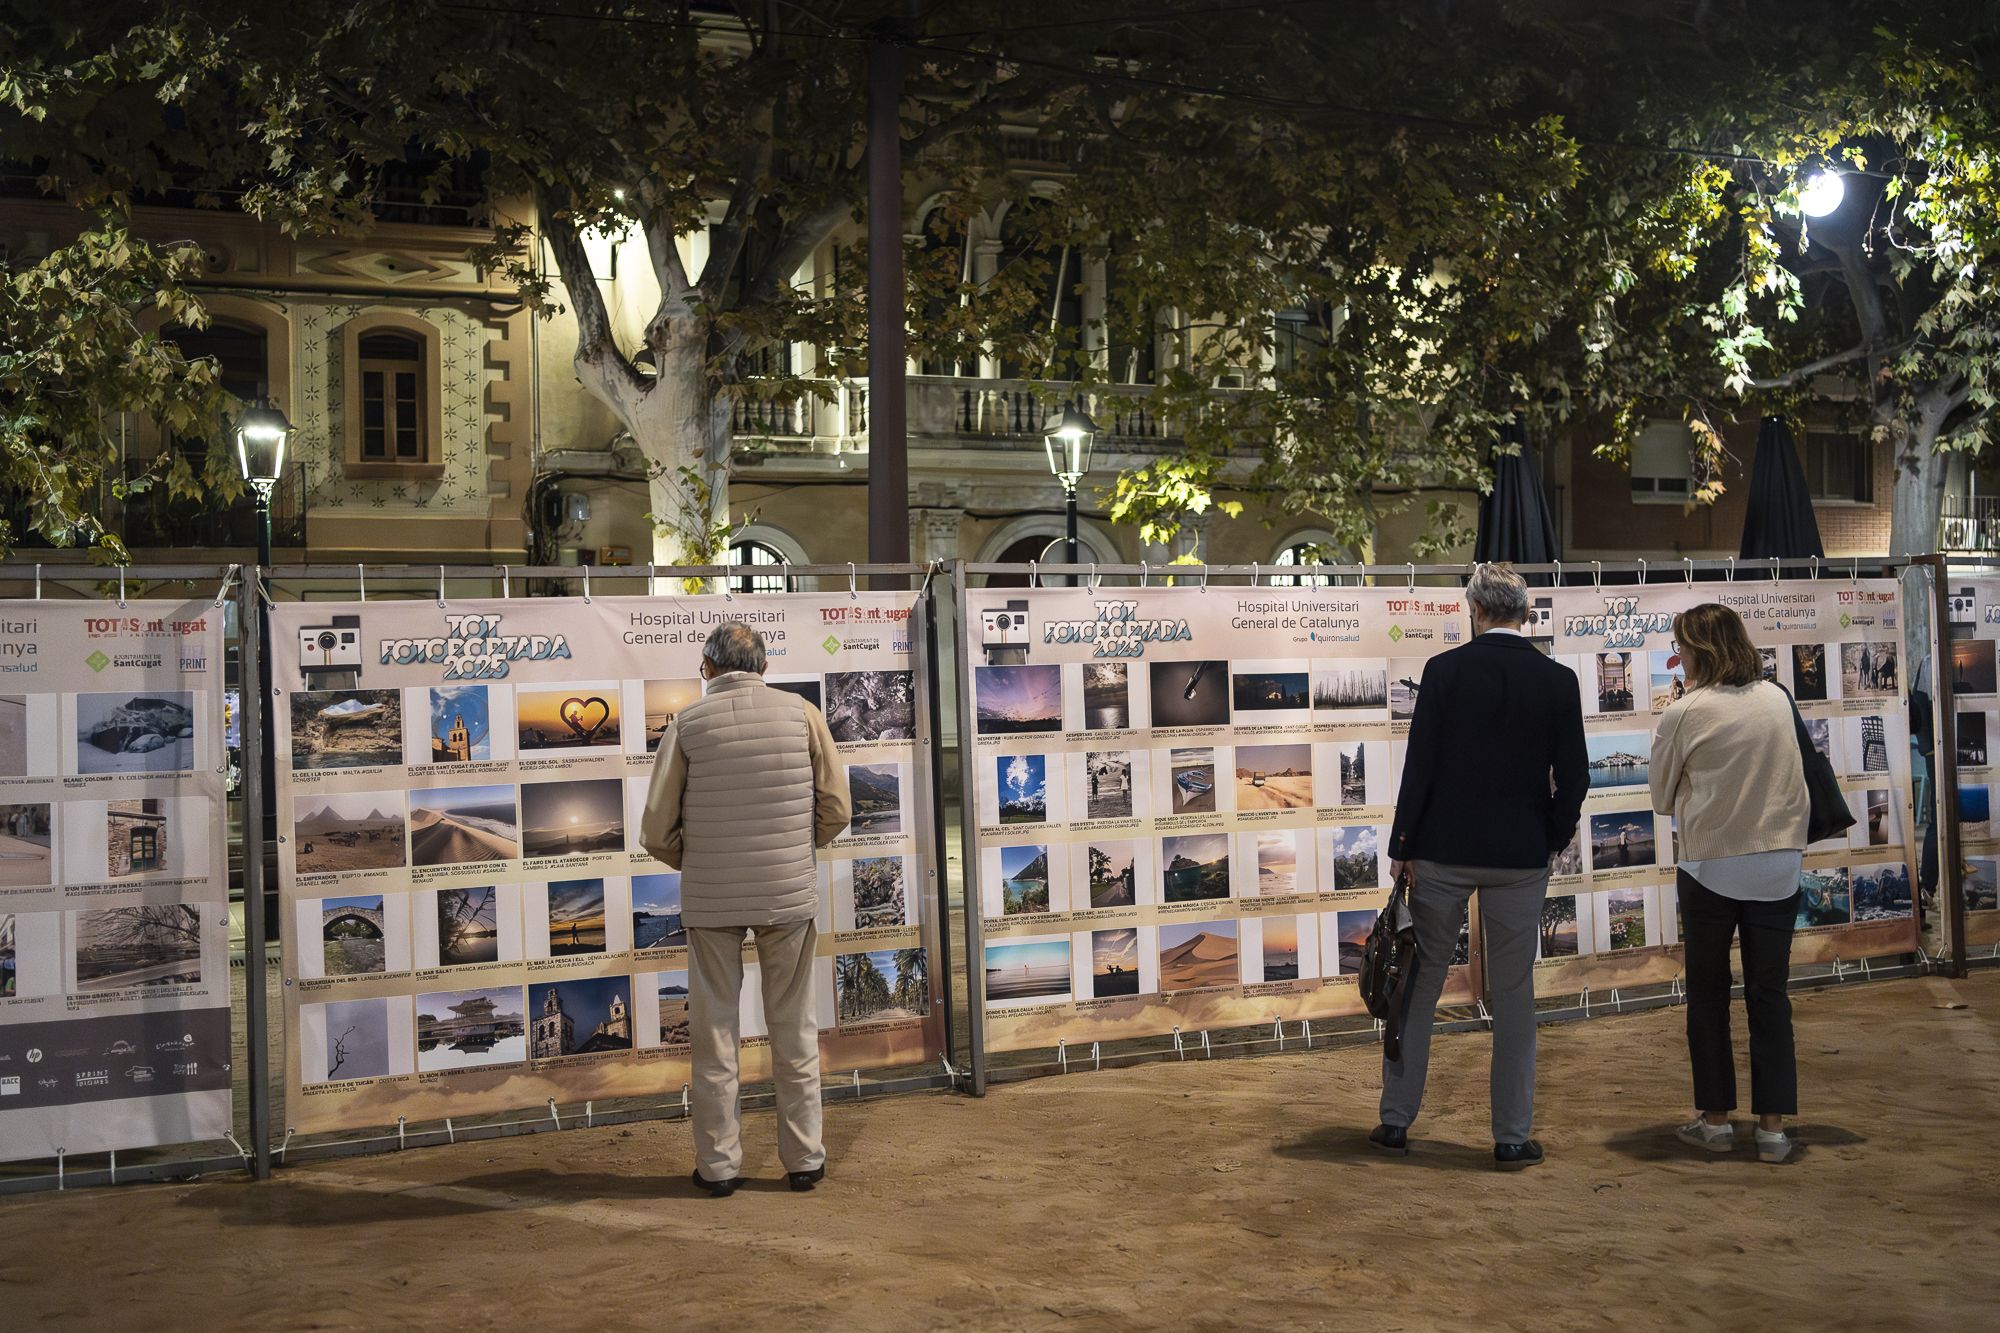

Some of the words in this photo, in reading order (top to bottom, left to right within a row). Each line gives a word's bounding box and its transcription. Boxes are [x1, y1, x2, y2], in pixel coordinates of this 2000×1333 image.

[1718, 594, 1758, 606] Hospital
[1762, 592, 1815, 604] Universitari
[1837, 591, 1854, 601] TOT
[1858, 591, 1895, 603] Sntugat
[1094, 600, 1138, 621] TOT
[1238, 601, 1288, 615] Hospital
[1292, 600, 1359, 612] Universitari
[1387, 600, 1409, 611] TOT
[1414, 600, 1460, 614] Sntugat
[1604, 596, 1639, 616] TOT
[630, 612, 694, 628] Hospital
[700, 610, 785, 624] Universitari
[820, 608, 848, 620] TOT
[854, 607, 912, 622] Sntugat
[1754, 609, 1766, 619] de
[1768, 608, 1816, 621] Catalunya
[84, 618, 120, 632] TOT
[130, 618, 206, 636] Sntugat
[446, 614, 502, 641] TOT
[1044, 618, 1192, 644] FOTOPORTADA
[1232, 616, 1278, 629] General
[1282, 617, 1296, 629] de
[1300, 616, 1359, 631] Catalunya
[622, 630, 682, 645] General
[687, 630, 706, 643] de
[1444, 633, 1460, 641] PRINT
[1604, 628, 1645, 648] 2025
[380, 634, 573, 664] FOTOPORTADA
[893, 642, 913, 652] PRINT
[1093, 636, 1144, 658] 2025
[114, 660, 162, 668] SantCugat
[180, 658, 206, 670] PRINT
[443, 653, 510, 680] 2025
[29, 1048, 40, 1062] hp
